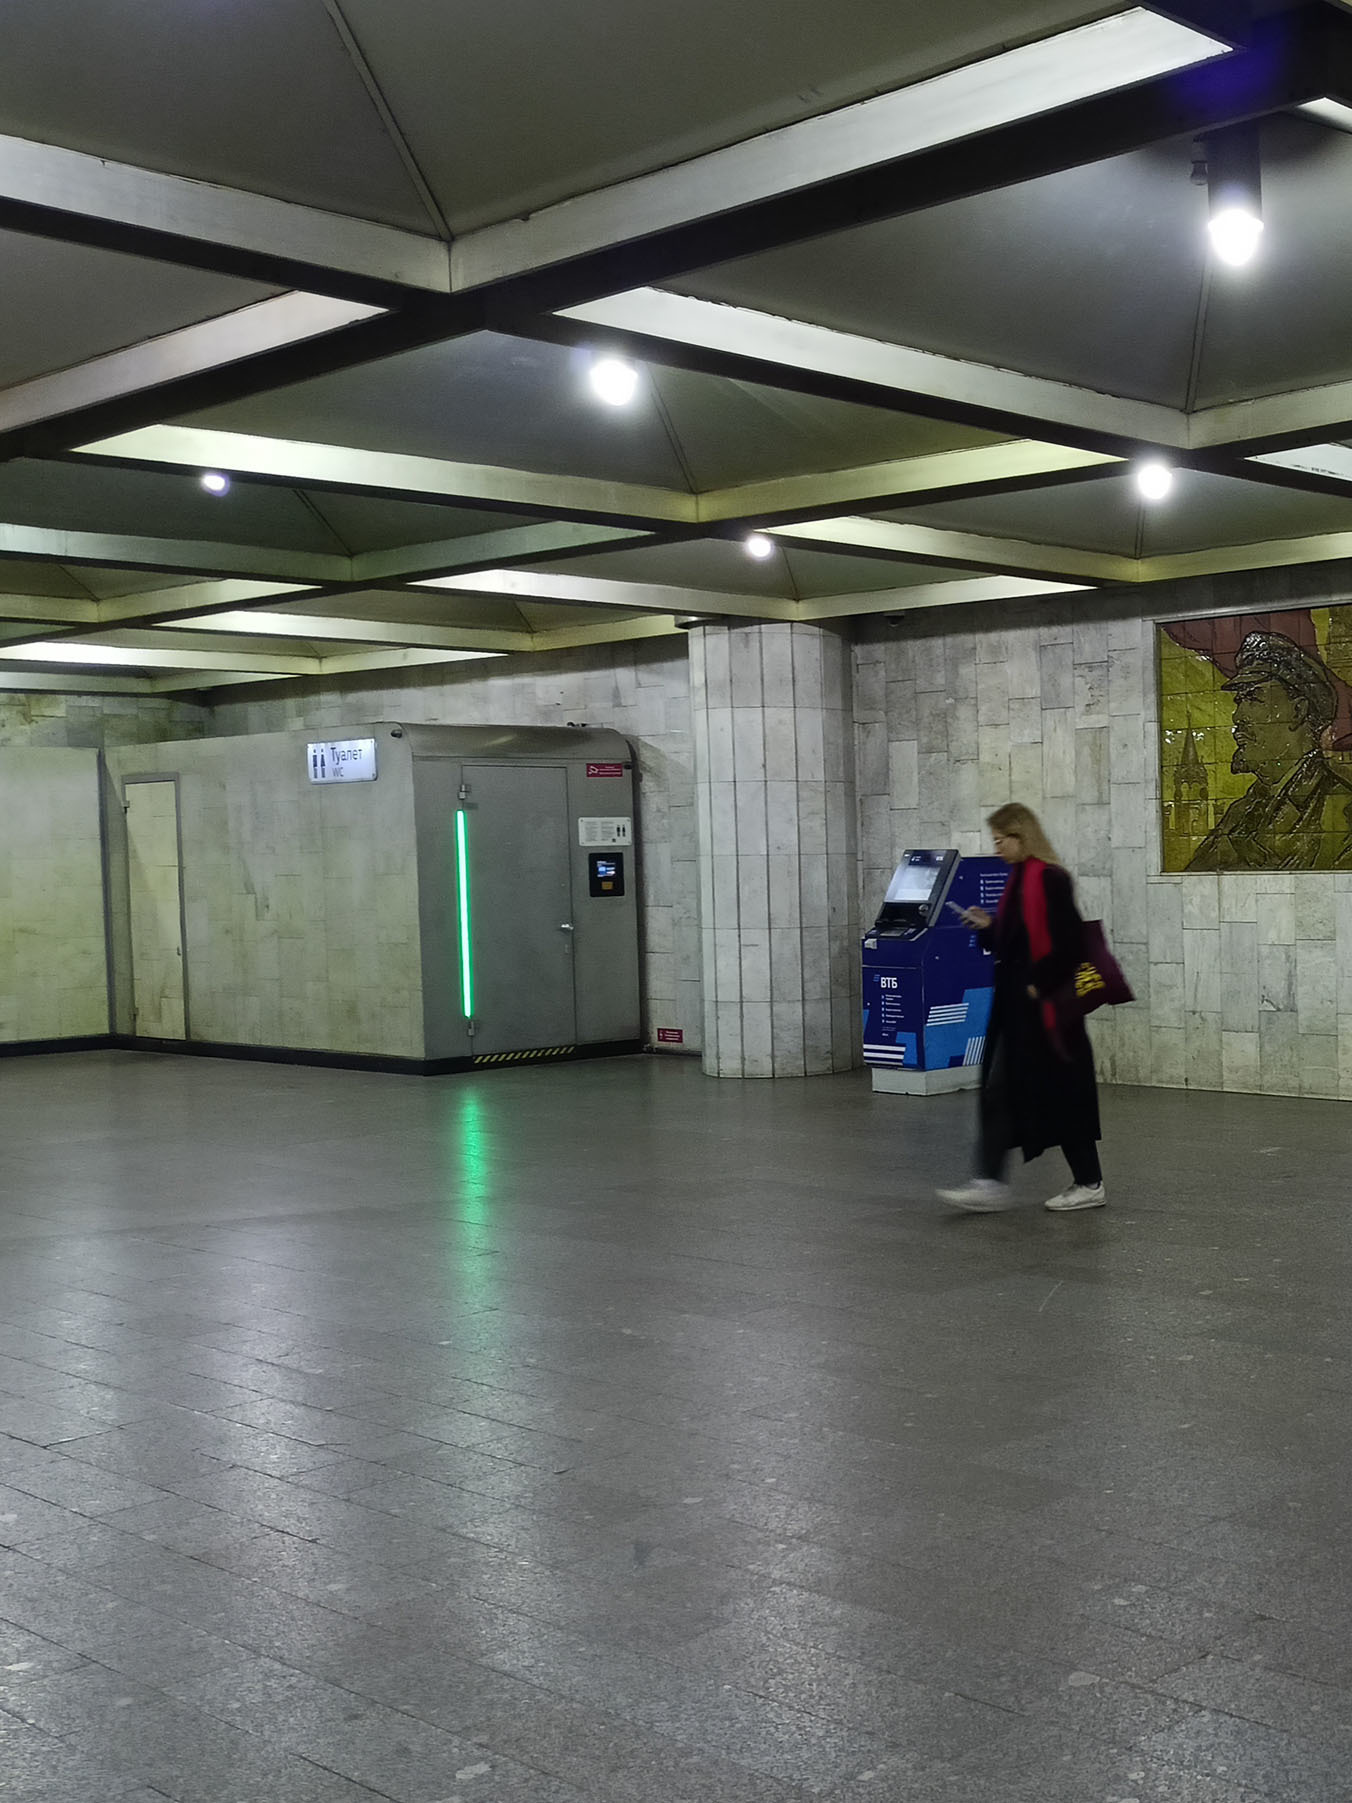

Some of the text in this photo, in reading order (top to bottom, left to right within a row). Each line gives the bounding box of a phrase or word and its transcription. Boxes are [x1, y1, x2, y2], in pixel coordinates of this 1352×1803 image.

[330, 746, 363, 765] Туалет
[331, 766, 344, 777] WC
[880, 976, 898, 989] ВТБ
